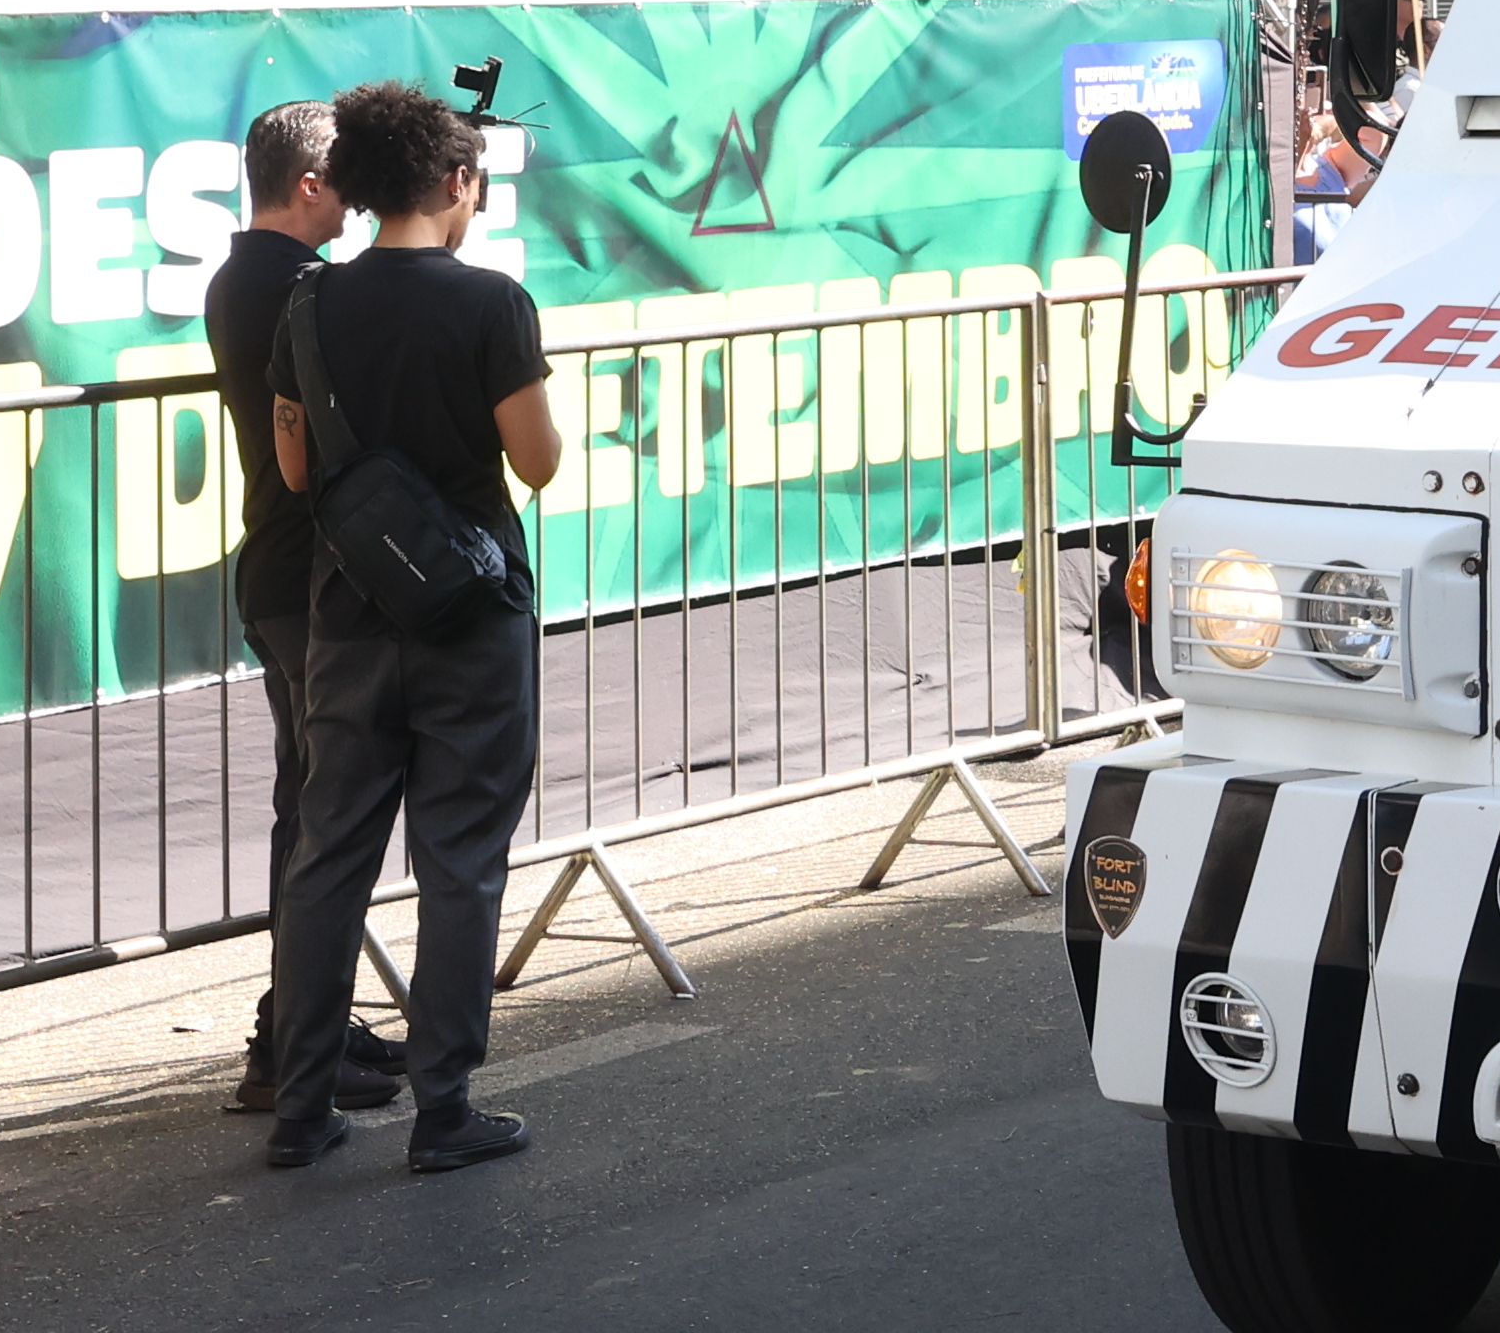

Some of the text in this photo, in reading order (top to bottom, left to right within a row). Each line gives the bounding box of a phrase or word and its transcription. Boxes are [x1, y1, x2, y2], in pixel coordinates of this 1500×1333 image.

[1075, 74, 1202, 116] UBERLÂNDIA
[503, 244, 1230, 517] ETEMBRO
[382, 534, 410, 564] FASHION
[1095, 856, 1137, 874] FORT
[1092, 876, 1137, 894] BLIND
